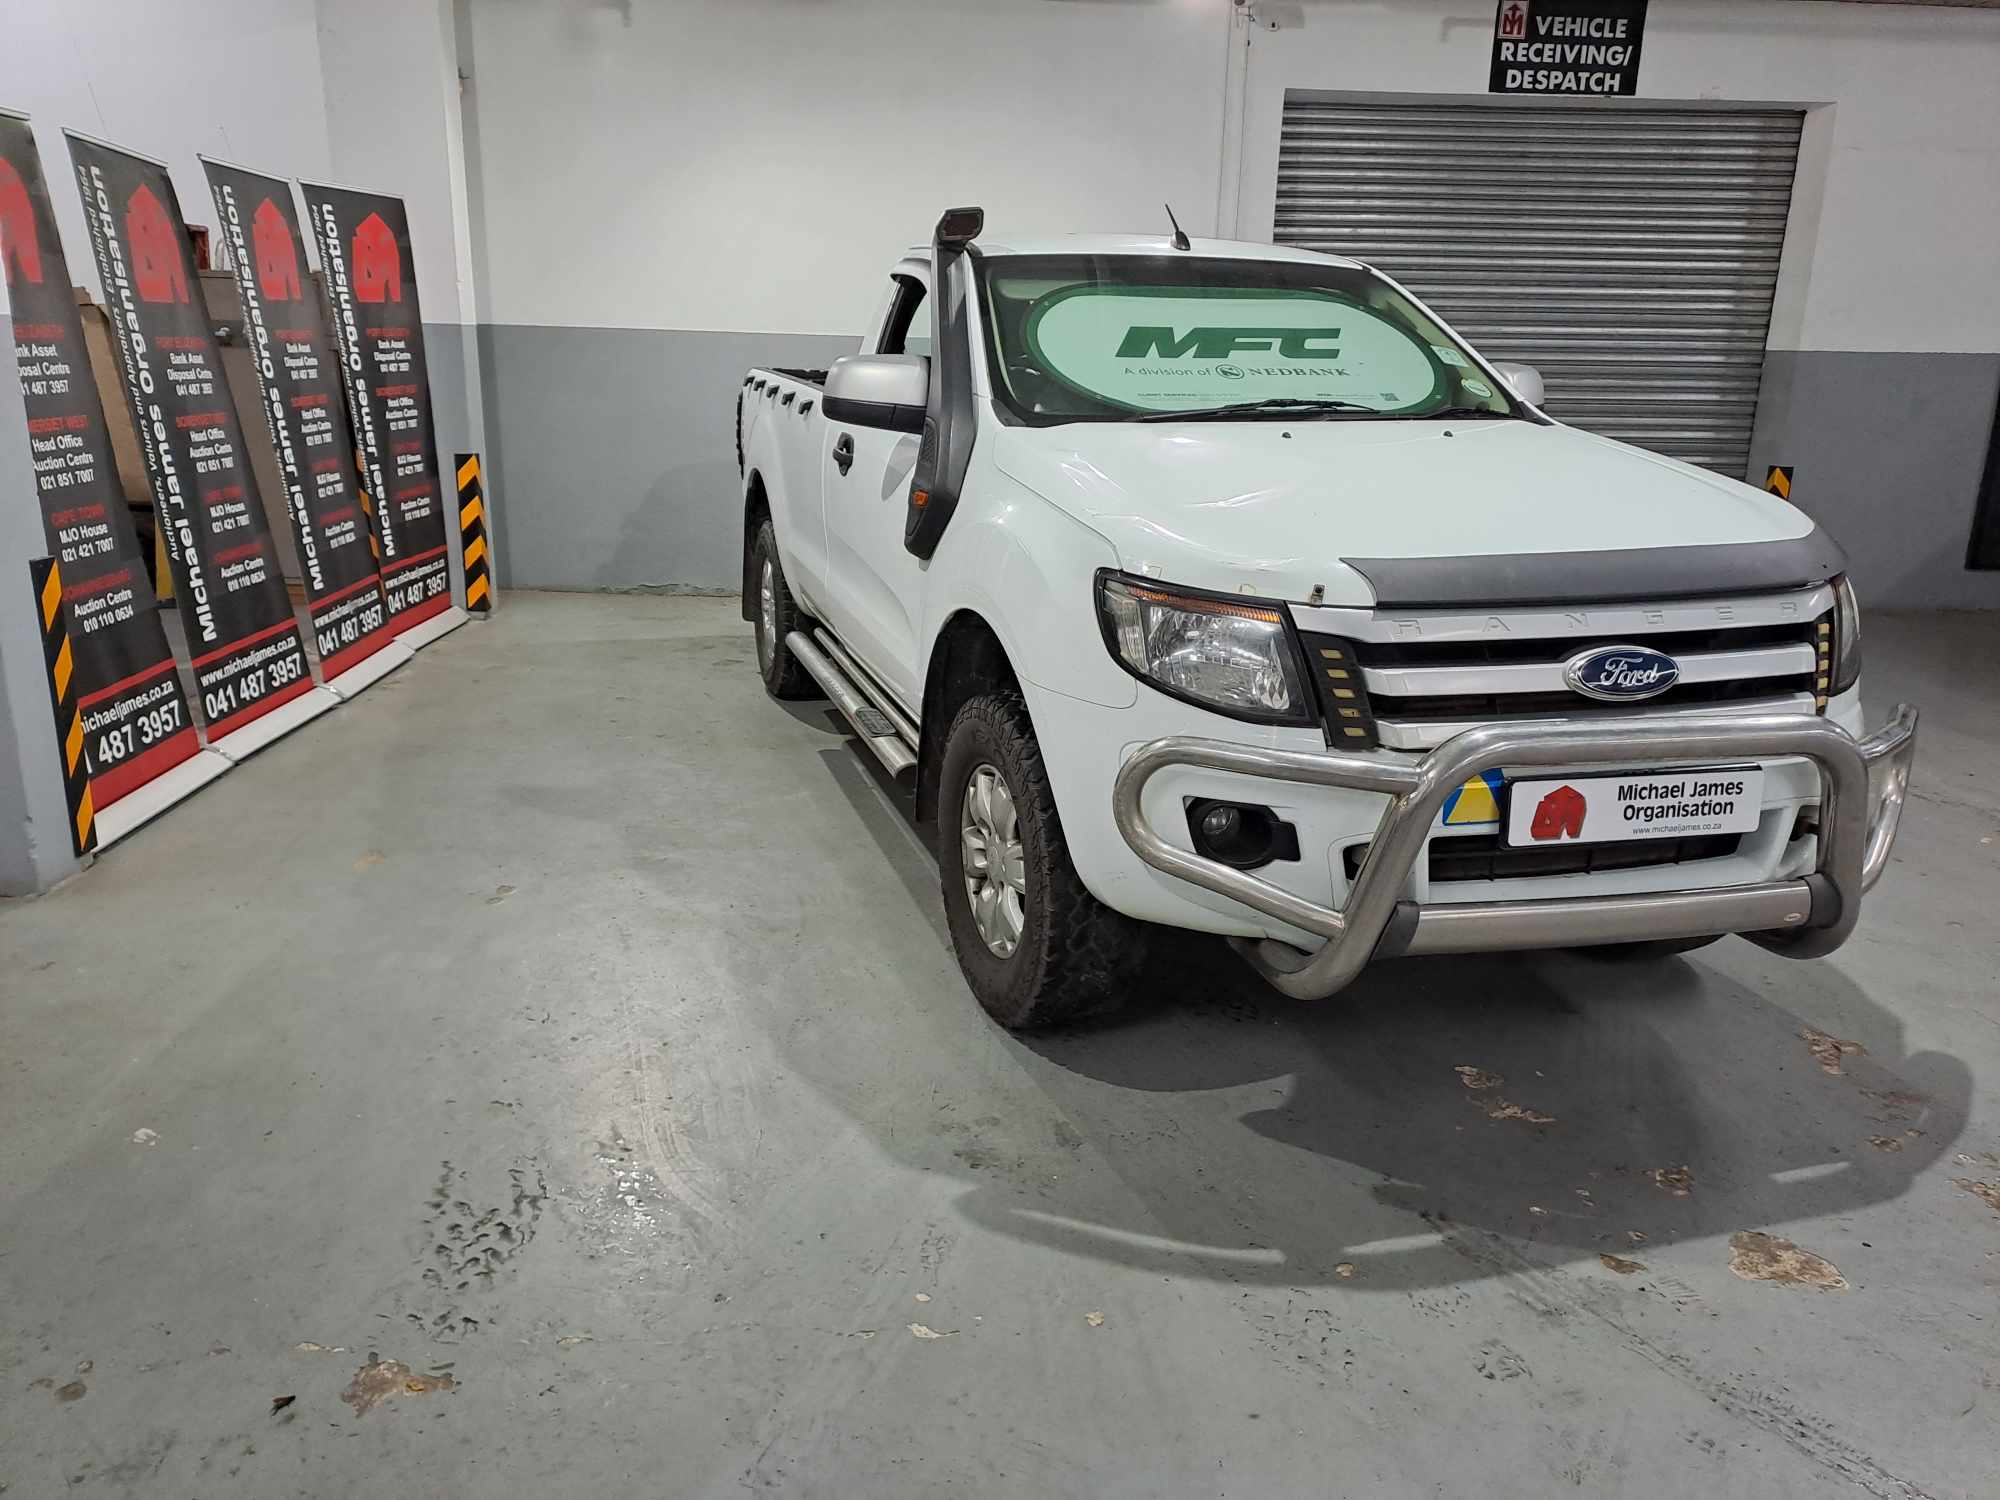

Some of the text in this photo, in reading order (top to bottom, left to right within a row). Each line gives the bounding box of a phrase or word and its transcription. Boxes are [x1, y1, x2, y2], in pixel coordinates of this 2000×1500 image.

[1536, 16, 1628, 38] VEHICLE
[1500, 42, 1632, 66] RECEIVING/
[1505, 69, 1621, 92] DESPATCH
[32, 343, 58, 357] Asset
[112, 306, 137, 385] Appraisers
[1115, 326, 1342, 359] MFC
[42, 361, 71, 376] Centre
[1124, 366, 1351, 377] A division of NEDBANK
[31, 380, 48, 395] 487
[90, 165, 217, 642] Michael James Organisation
[130, 386, 144, 415] and
[355, 378, 378, 457] James
[32, 434, 83, 452] Head Office
[269, 387, 298, 478] James
[140, 418, 158, 472] Valuers
[66, 452, 94, 467] Centre
[40, 474, 56, 490] 021
[57, 471, 74, 487] 851
[369, 463, 395, 557] Michael
[80, 523, 109, 540] House
[289, 485, 324, 590] Michael
[61, 545, 78, 562] 021
[78, 541, 95, 558] 421
[74, 588, 133, 618] Auction Centre
[387, 571, 447, 614] 041 487 3957
[98, 611, 115, 627] 110
[318, 604, 383, 656] 041 487 3957
[200, 636, 297, 687] www.michaeljames.co.za
[205, 653, 302, 719] 041 487 3957
[98, 723, 134, 764] 487
[137, 699, 181, 744] 3957
[1618, 781, 1744, 801] Michael James
[1623, 800, 1734, 822] Organisation
[1632, 823, 1722, 835] www.michaeljames.co.za
